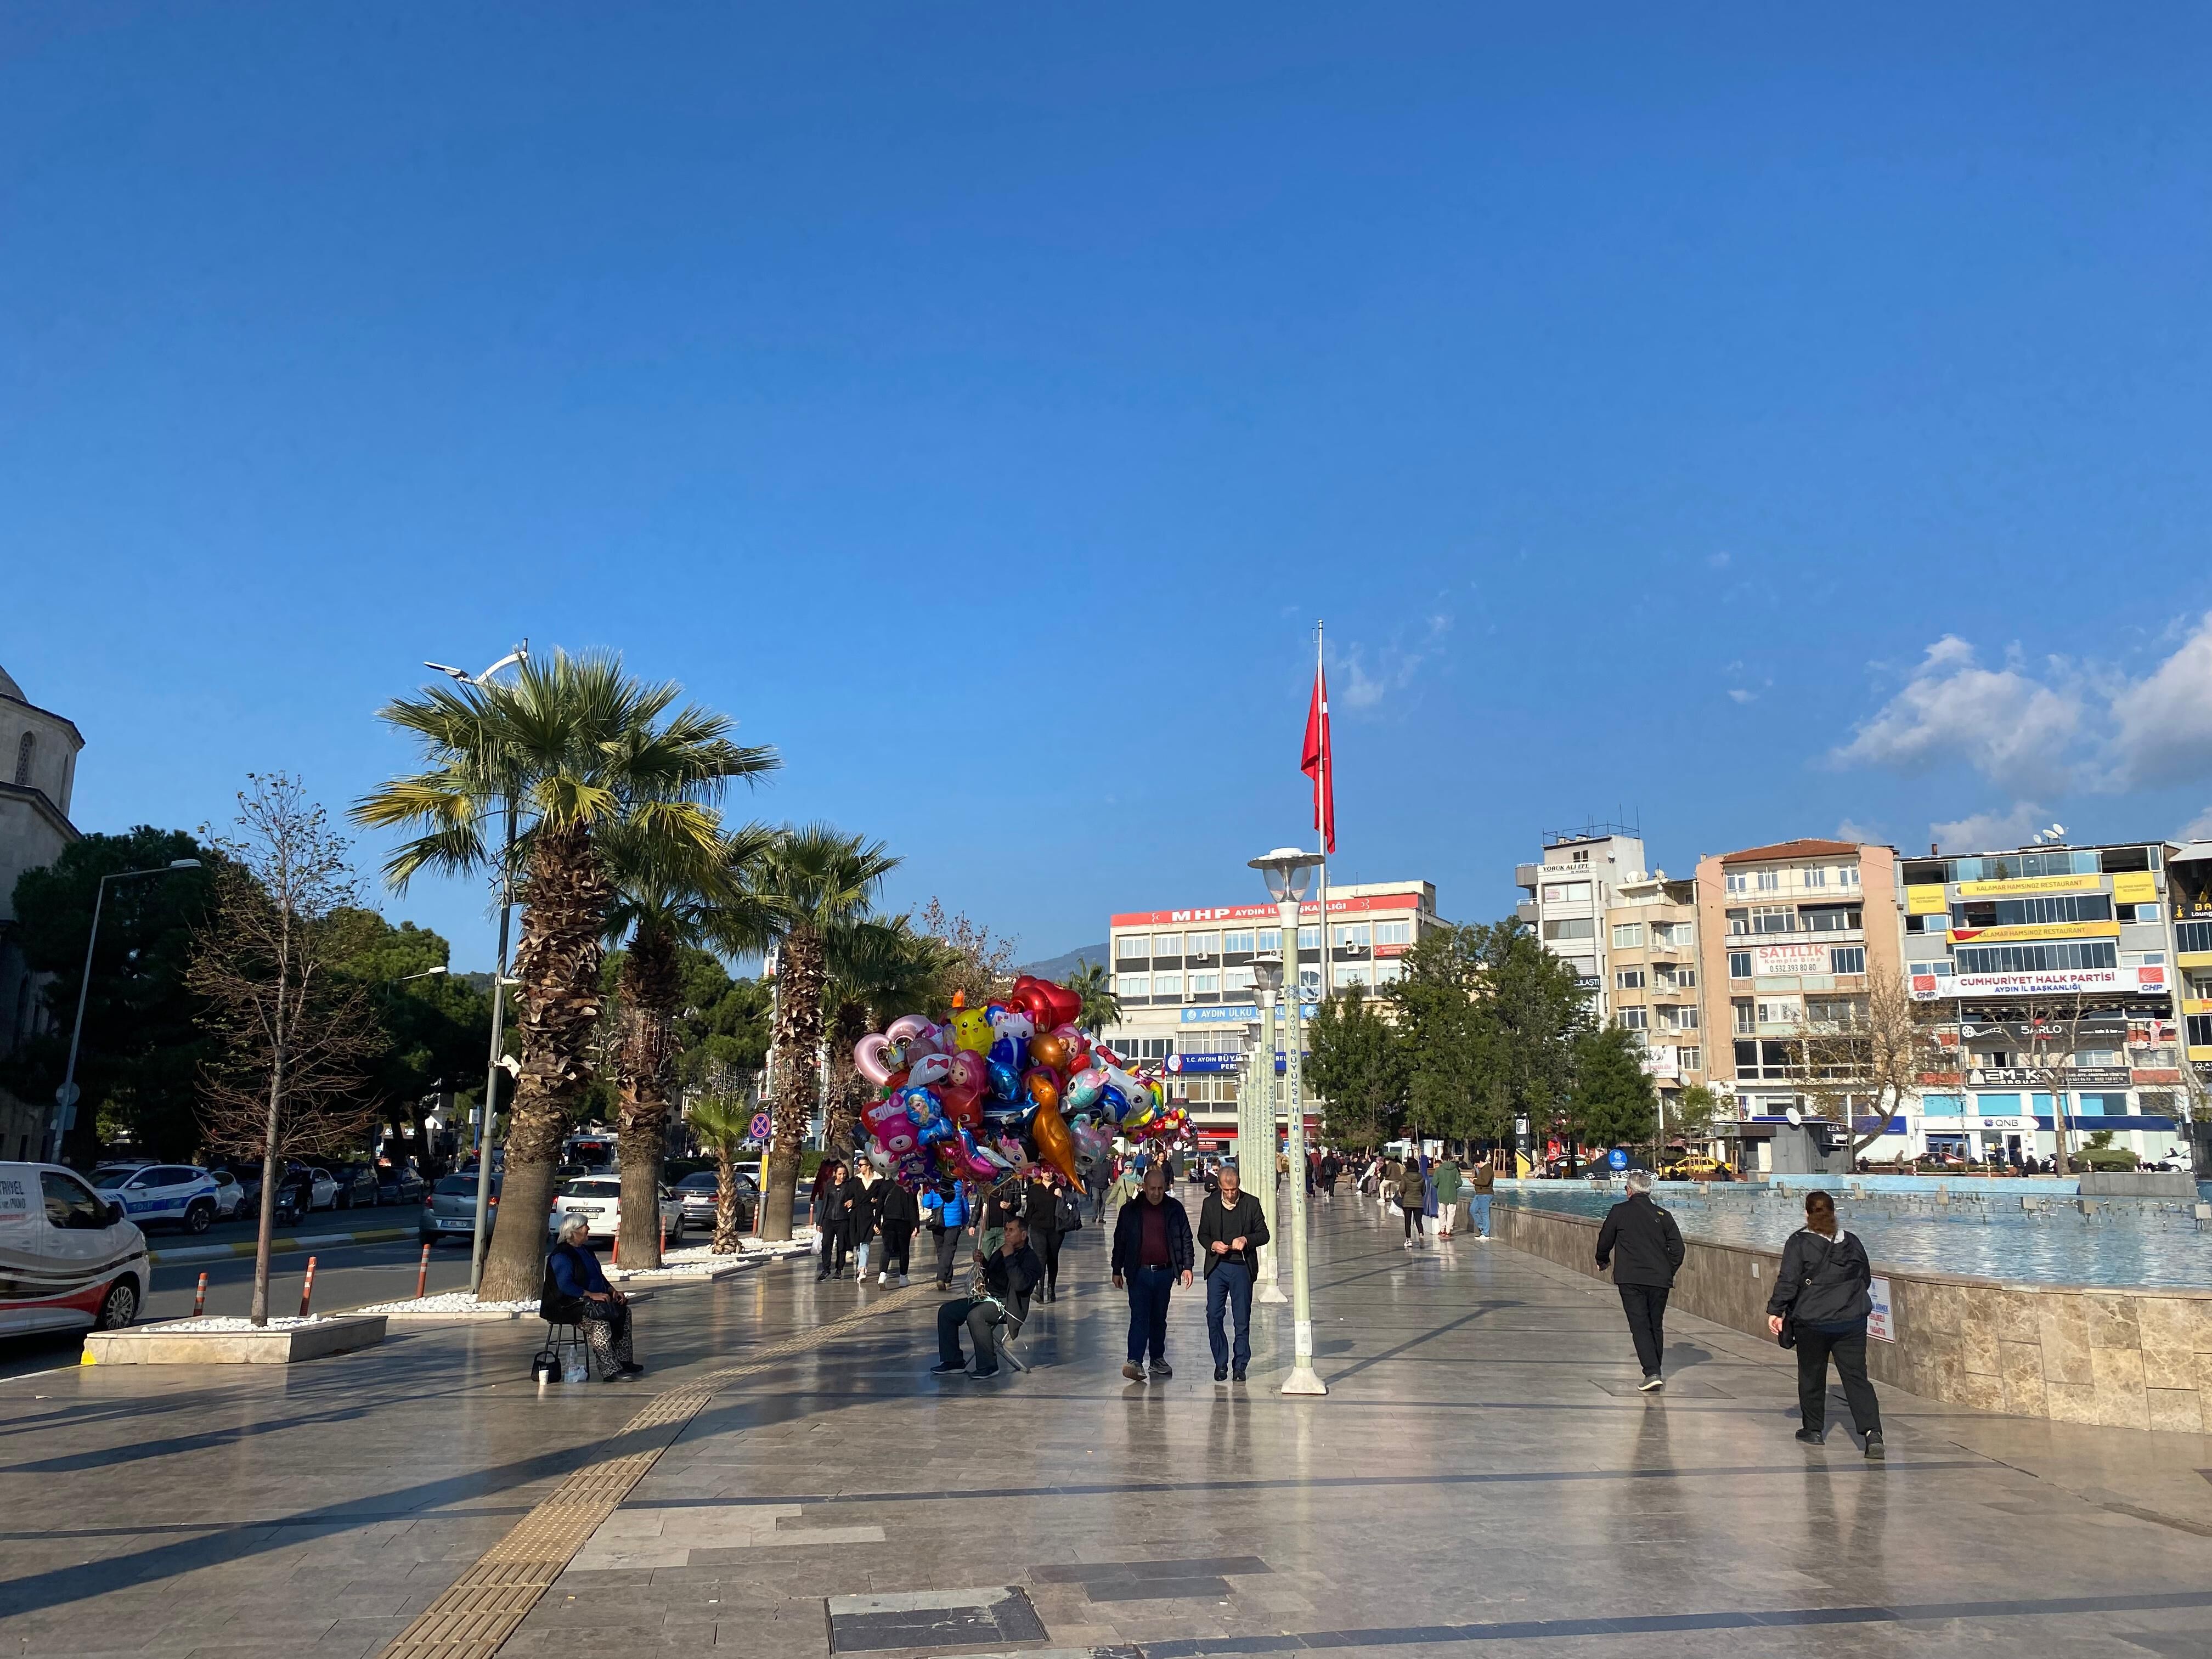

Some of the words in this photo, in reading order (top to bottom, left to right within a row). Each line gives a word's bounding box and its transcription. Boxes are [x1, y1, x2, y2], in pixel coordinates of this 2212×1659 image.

[2040, 880, 2083, 888] RESTAURANT
[1172, 908, 1230, 922] MHP
[1235, 908, 1265, 917] AYDIN
[1267, 906, 1277, 915] İL
[1979, 929, 2008, 938] KALAMAR
[1759, 945, 1825, 958] SATILIK
[1960, 975, 2033, 986] CUMHURİYET
[2036, 975, 2067, 984] HALK
[2070, 972, 2115, 982] PARTİSİ
[2030, 983, 2081, 992] BAŞKANLIĞI
[1201, 1008, 1226, 1018] AYDIN
[1229, 1006, 1252, 1017] ÜLKÜ
[1290, 1049, 1299, 1131] BÜYÜKŞEHİR
